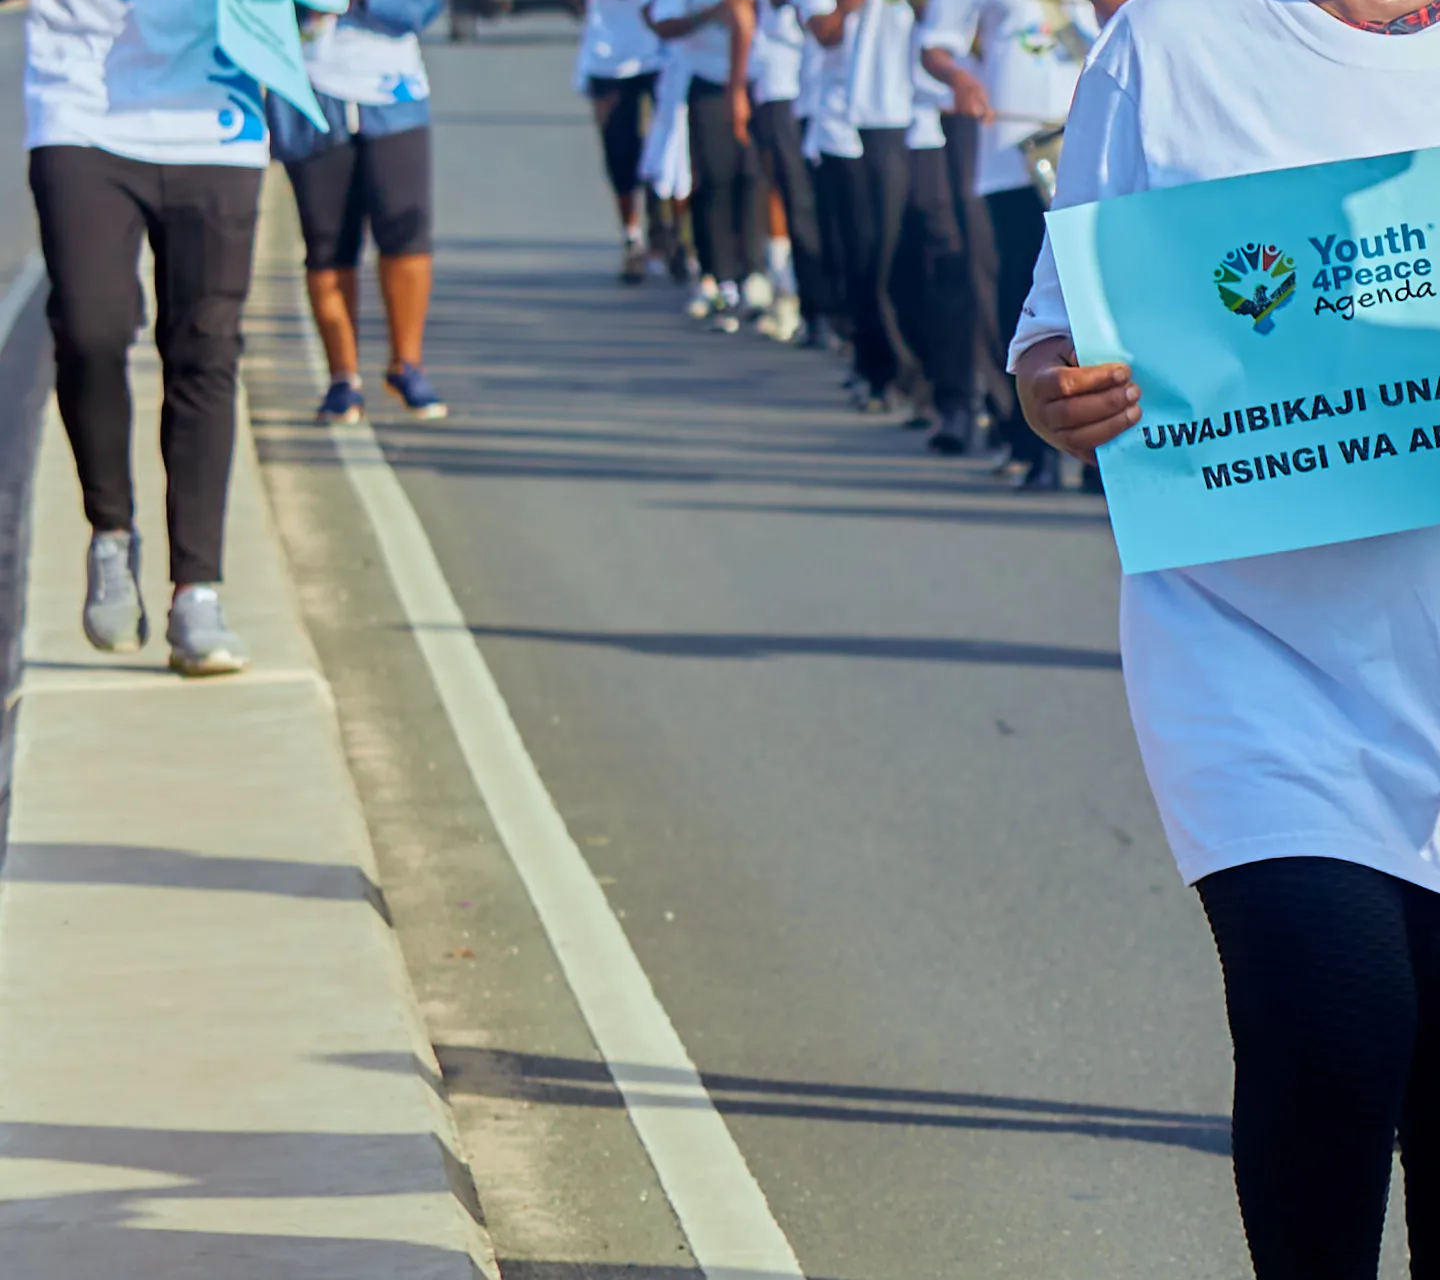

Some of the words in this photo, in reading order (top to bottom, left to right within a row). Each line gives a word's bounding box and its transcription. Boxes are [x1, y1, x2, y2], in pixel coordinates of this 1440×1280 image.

[1308, 222, 1428, 266] Youth
[1312, 255, 1432, 293] 4Peace
[1313, 277, 1437, 320] Agenda
[1142, 387, 1368, 451] UWAJIBIKAJI
[1201, 445, 1329, 490] MSINGI
[1339, 435, 1396, 465] WA
